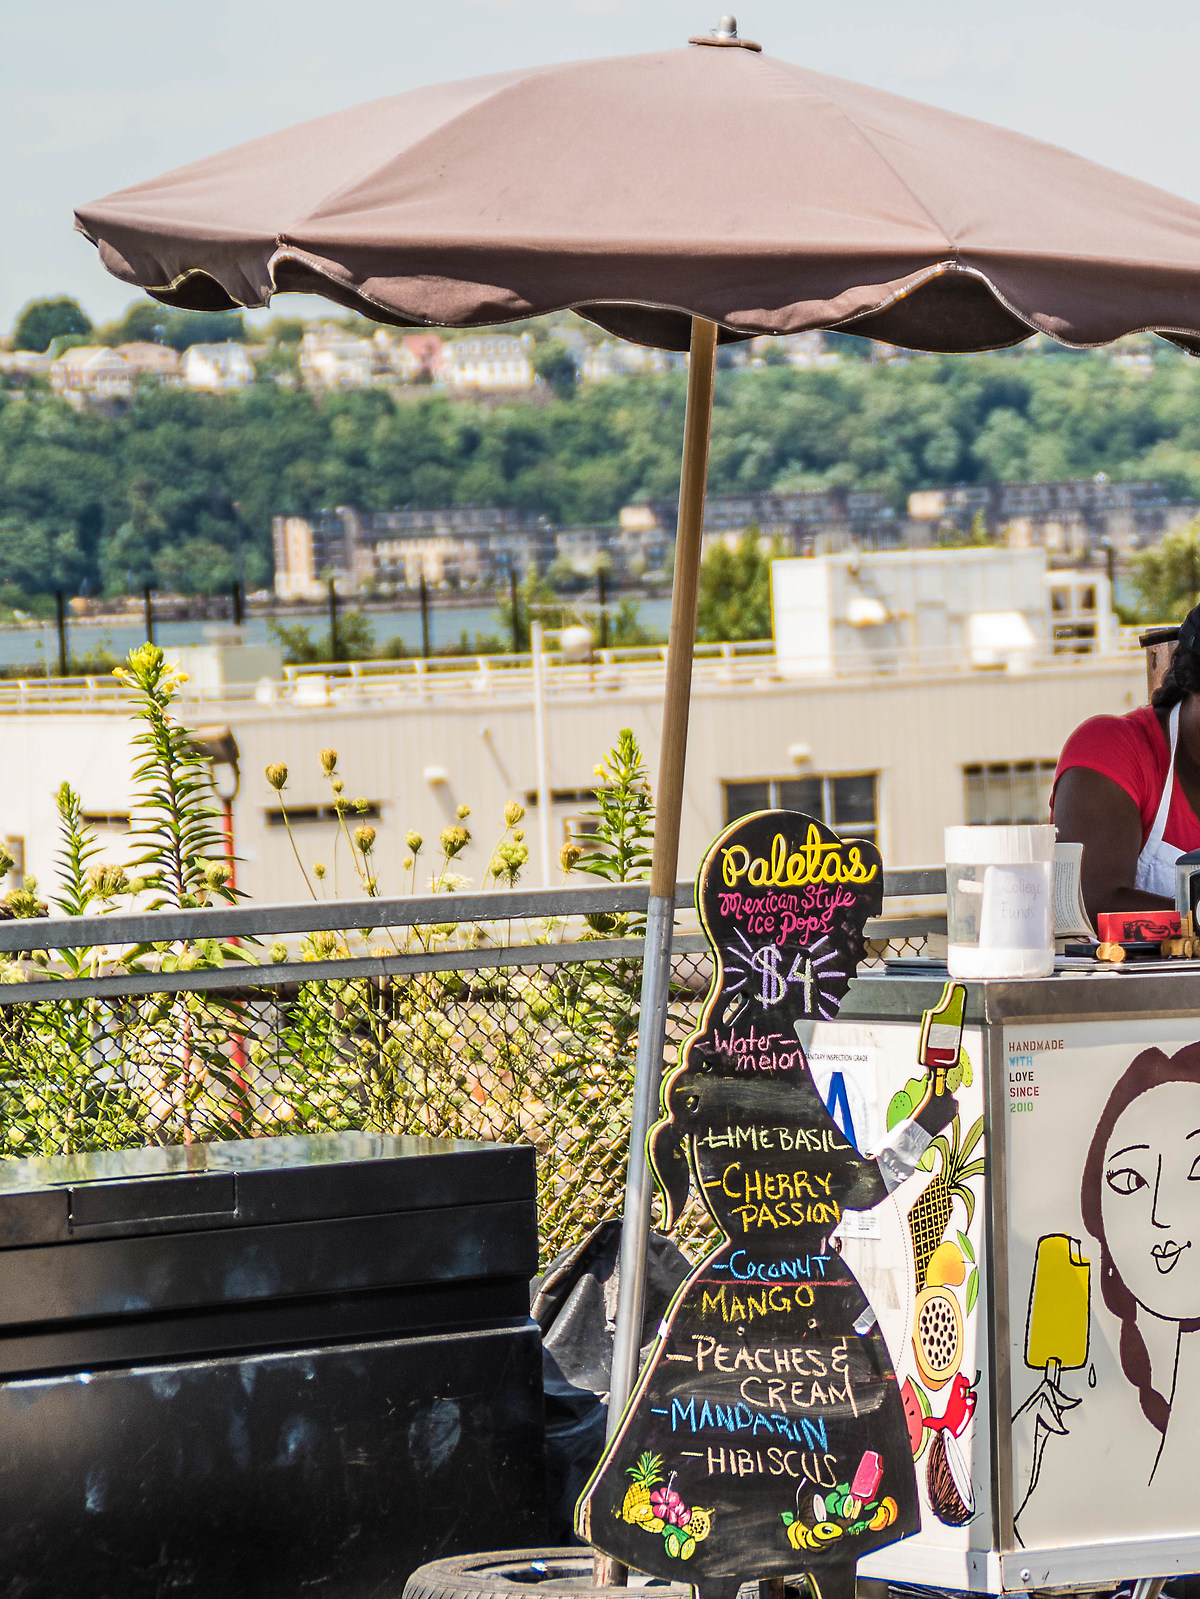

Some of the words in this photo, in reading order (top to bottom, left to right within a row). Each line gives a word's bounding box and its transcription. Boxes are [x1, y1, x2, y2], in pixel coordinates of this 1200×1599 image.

[721, 824, 877, 887] Paletas
[718, 890, 798, 919] Mexican
[801, 882, 856, 920] Style
[1001, 901, 1036, 920] Funds
[752, 944, 814, 1014] $4
[1008, 1040, 1064, 1052] HANDMADE
[736, 1049, 804, 1070] melon
[1009, 1056, 1033, 1067] WITH
[1009, 1071, 1034, 1083] LOVE
[1009, 1086, 1039, 1098] SINCE
[826, 1072, 858, 1150] A
[1010, 1102, 1034, 1113] 2010
[773, 1127, 852, 1152] BASIL
[732, 1200, 840, 1232] PASSION
[740, 1366, 858, 1417] CREAM
